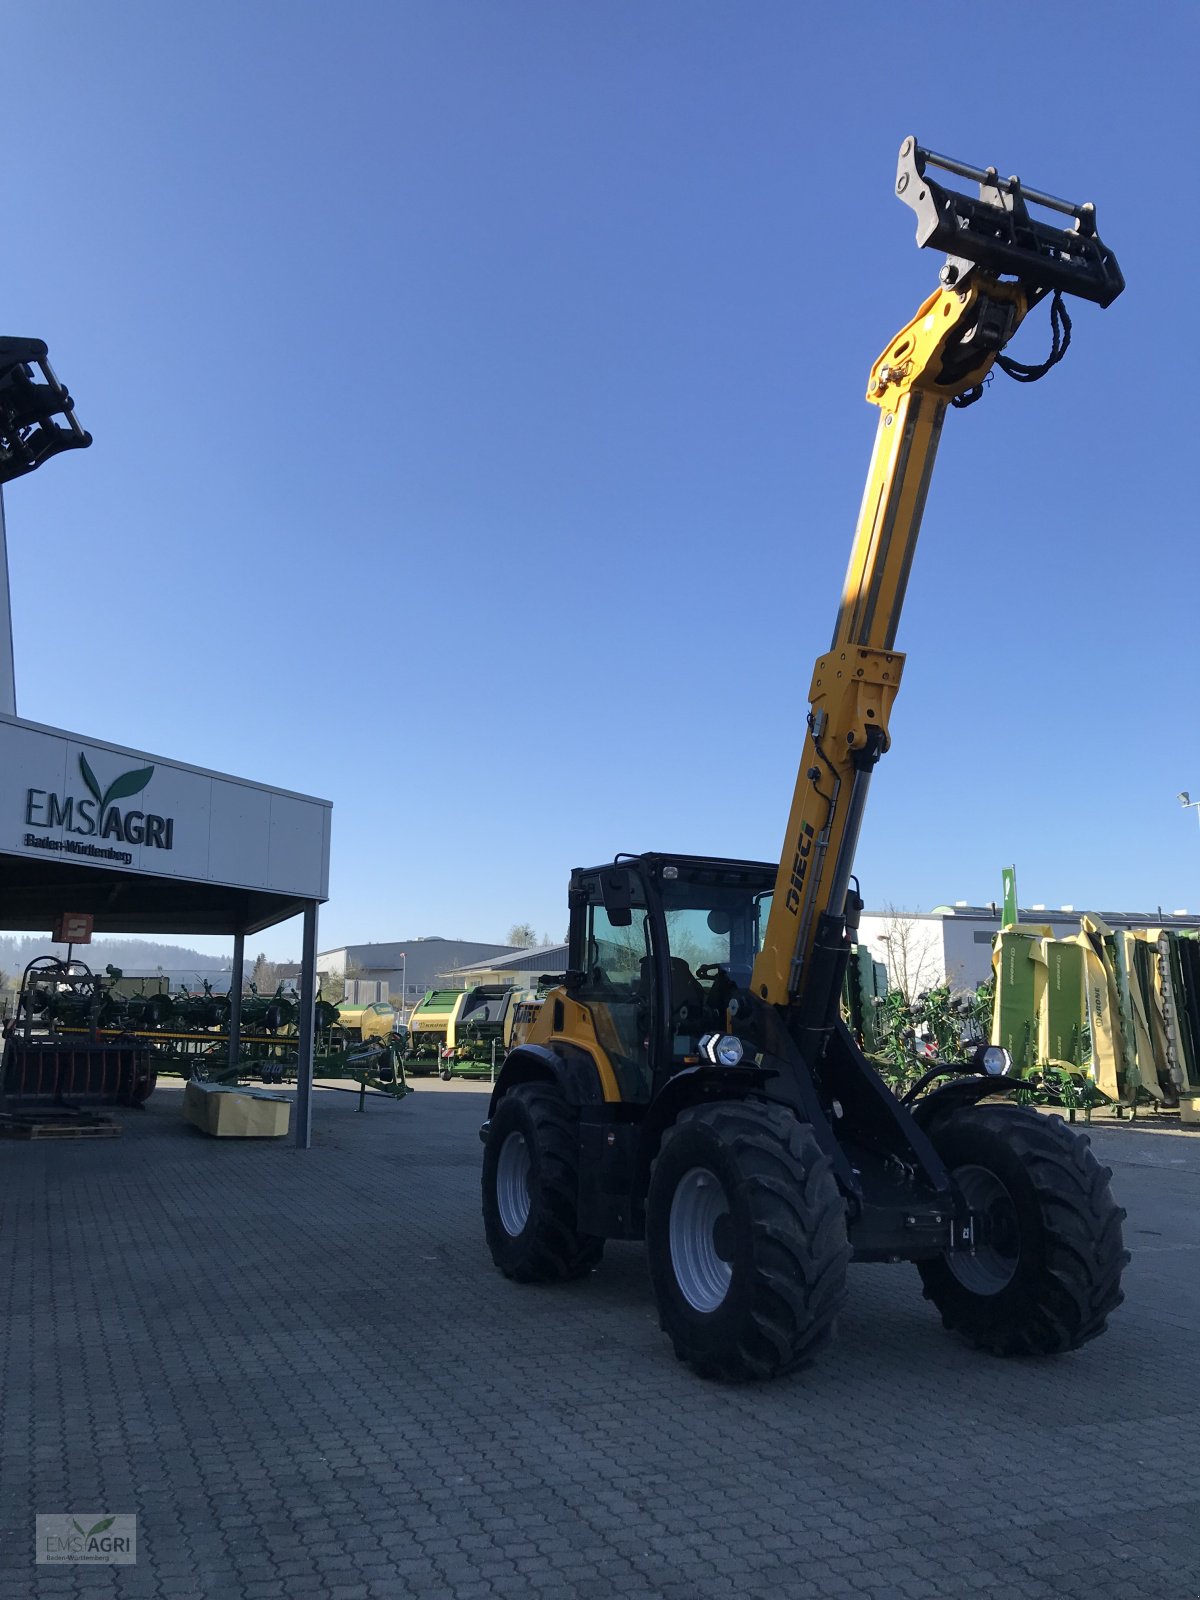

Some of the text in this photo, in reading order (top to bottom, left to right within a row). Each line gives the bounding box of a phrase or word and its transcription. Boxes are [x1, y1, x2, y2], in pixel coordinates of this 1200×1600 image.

[24, 832, 133, 865] Baden-Württemberg
[785, 820, 815, 917] DIECI
[1094, 987, 1103, 1019] KRONE
